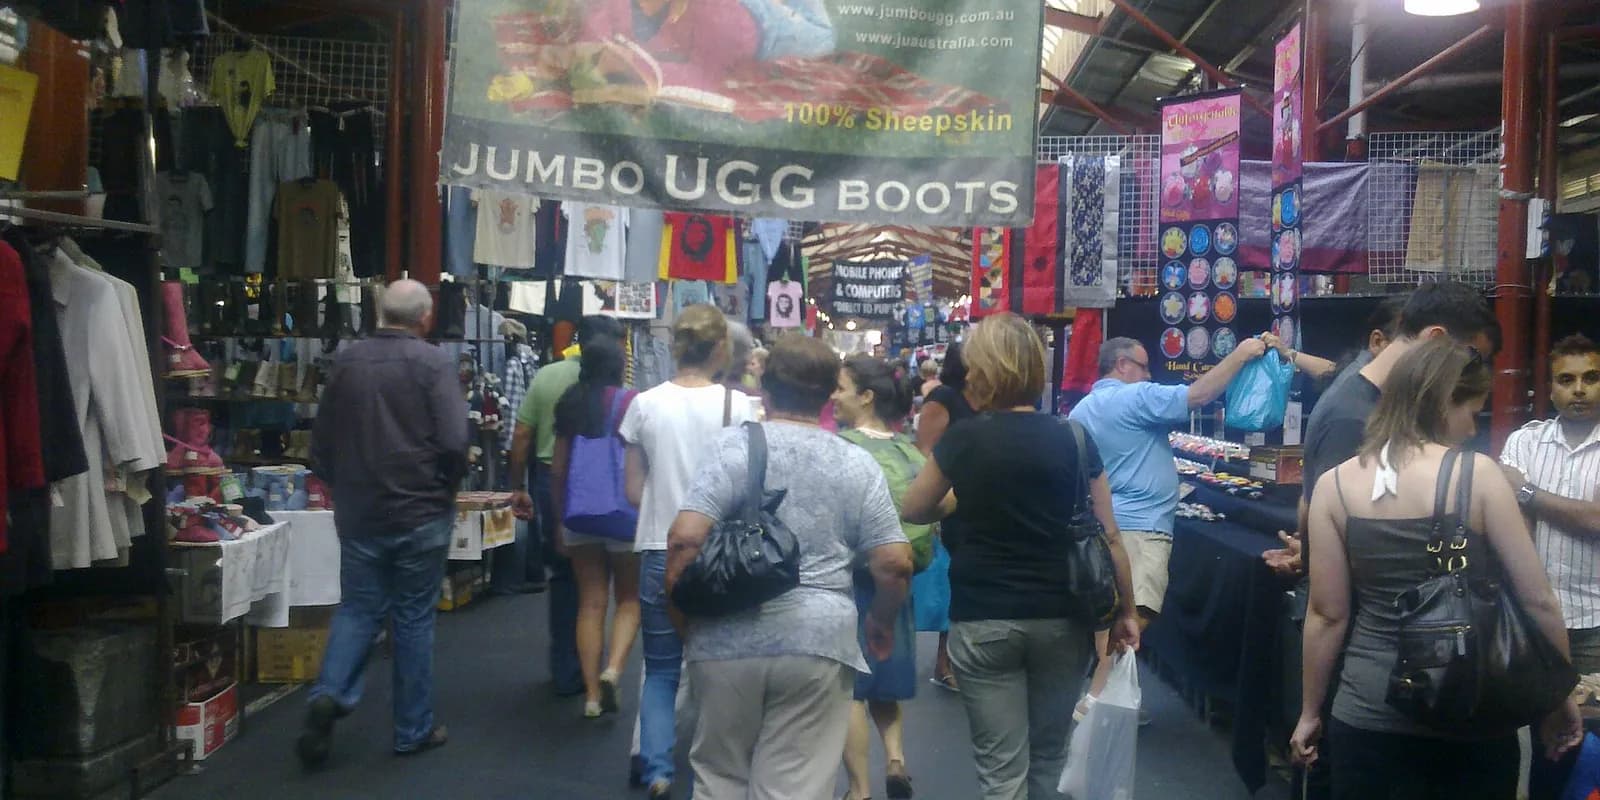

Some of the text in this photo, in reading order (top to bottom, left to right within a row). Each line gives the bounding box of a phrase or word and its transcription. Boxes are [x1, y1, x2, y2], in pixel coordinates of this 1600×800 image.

[838, 3, 1015, 26] www.jumbougg.com.au
[855, 31, 1014, 50] www.juaustralia.com
[784, 102, 1012, 136] 100% Sheepskin
[453, 143, 1020, 215] JUMBO UGG BOOTS
[835, 265, 867, 279] MOBILE
[836, 283, 901, 299] & COMPUTERS
